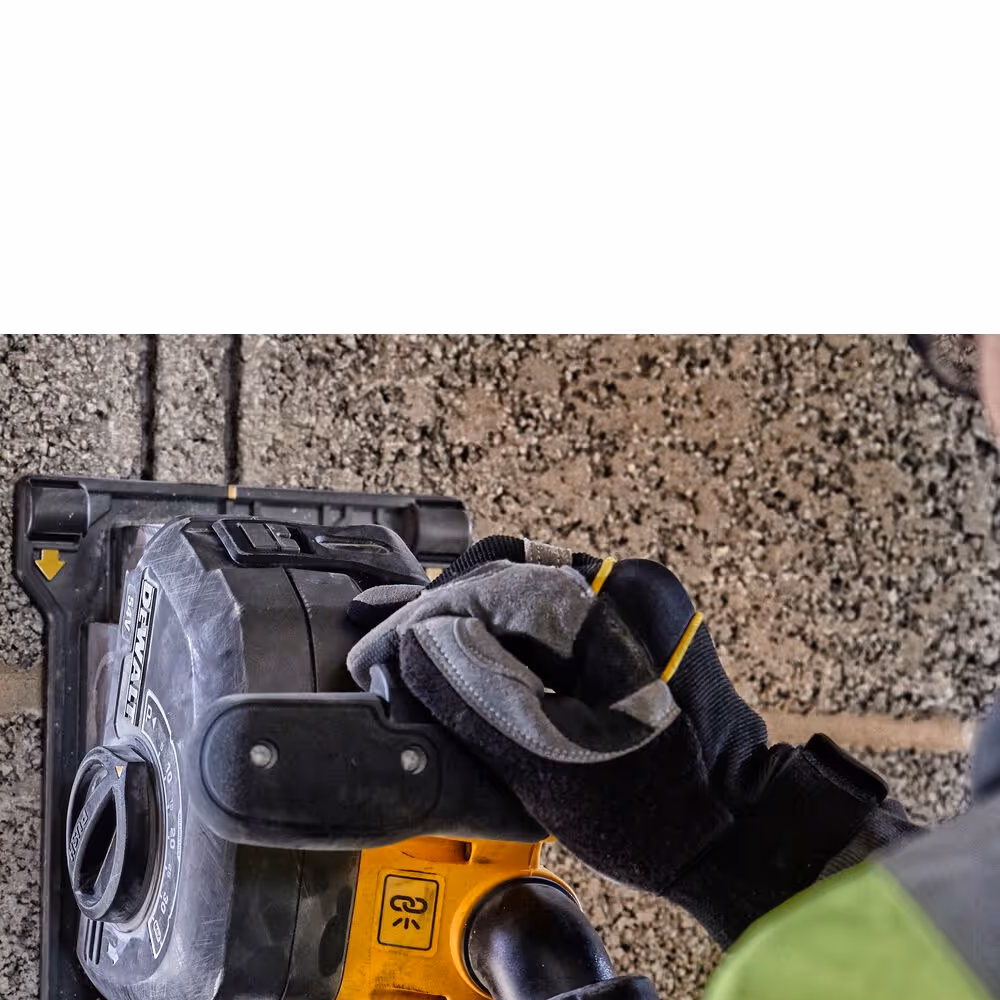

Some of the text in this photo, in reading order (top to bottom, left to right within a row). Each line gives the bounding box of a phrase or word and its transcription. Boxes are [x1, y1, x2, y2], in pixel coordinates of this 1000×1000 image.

[124, 596, 135, 632] 54V
[125, 580, 155, 724] DEWALT
[166, 762, 173, 784] 10
[69, 809, 89, 862] PUSH
[170, 827, 176, 850] 20
[161, 892, 169, 915] 30
